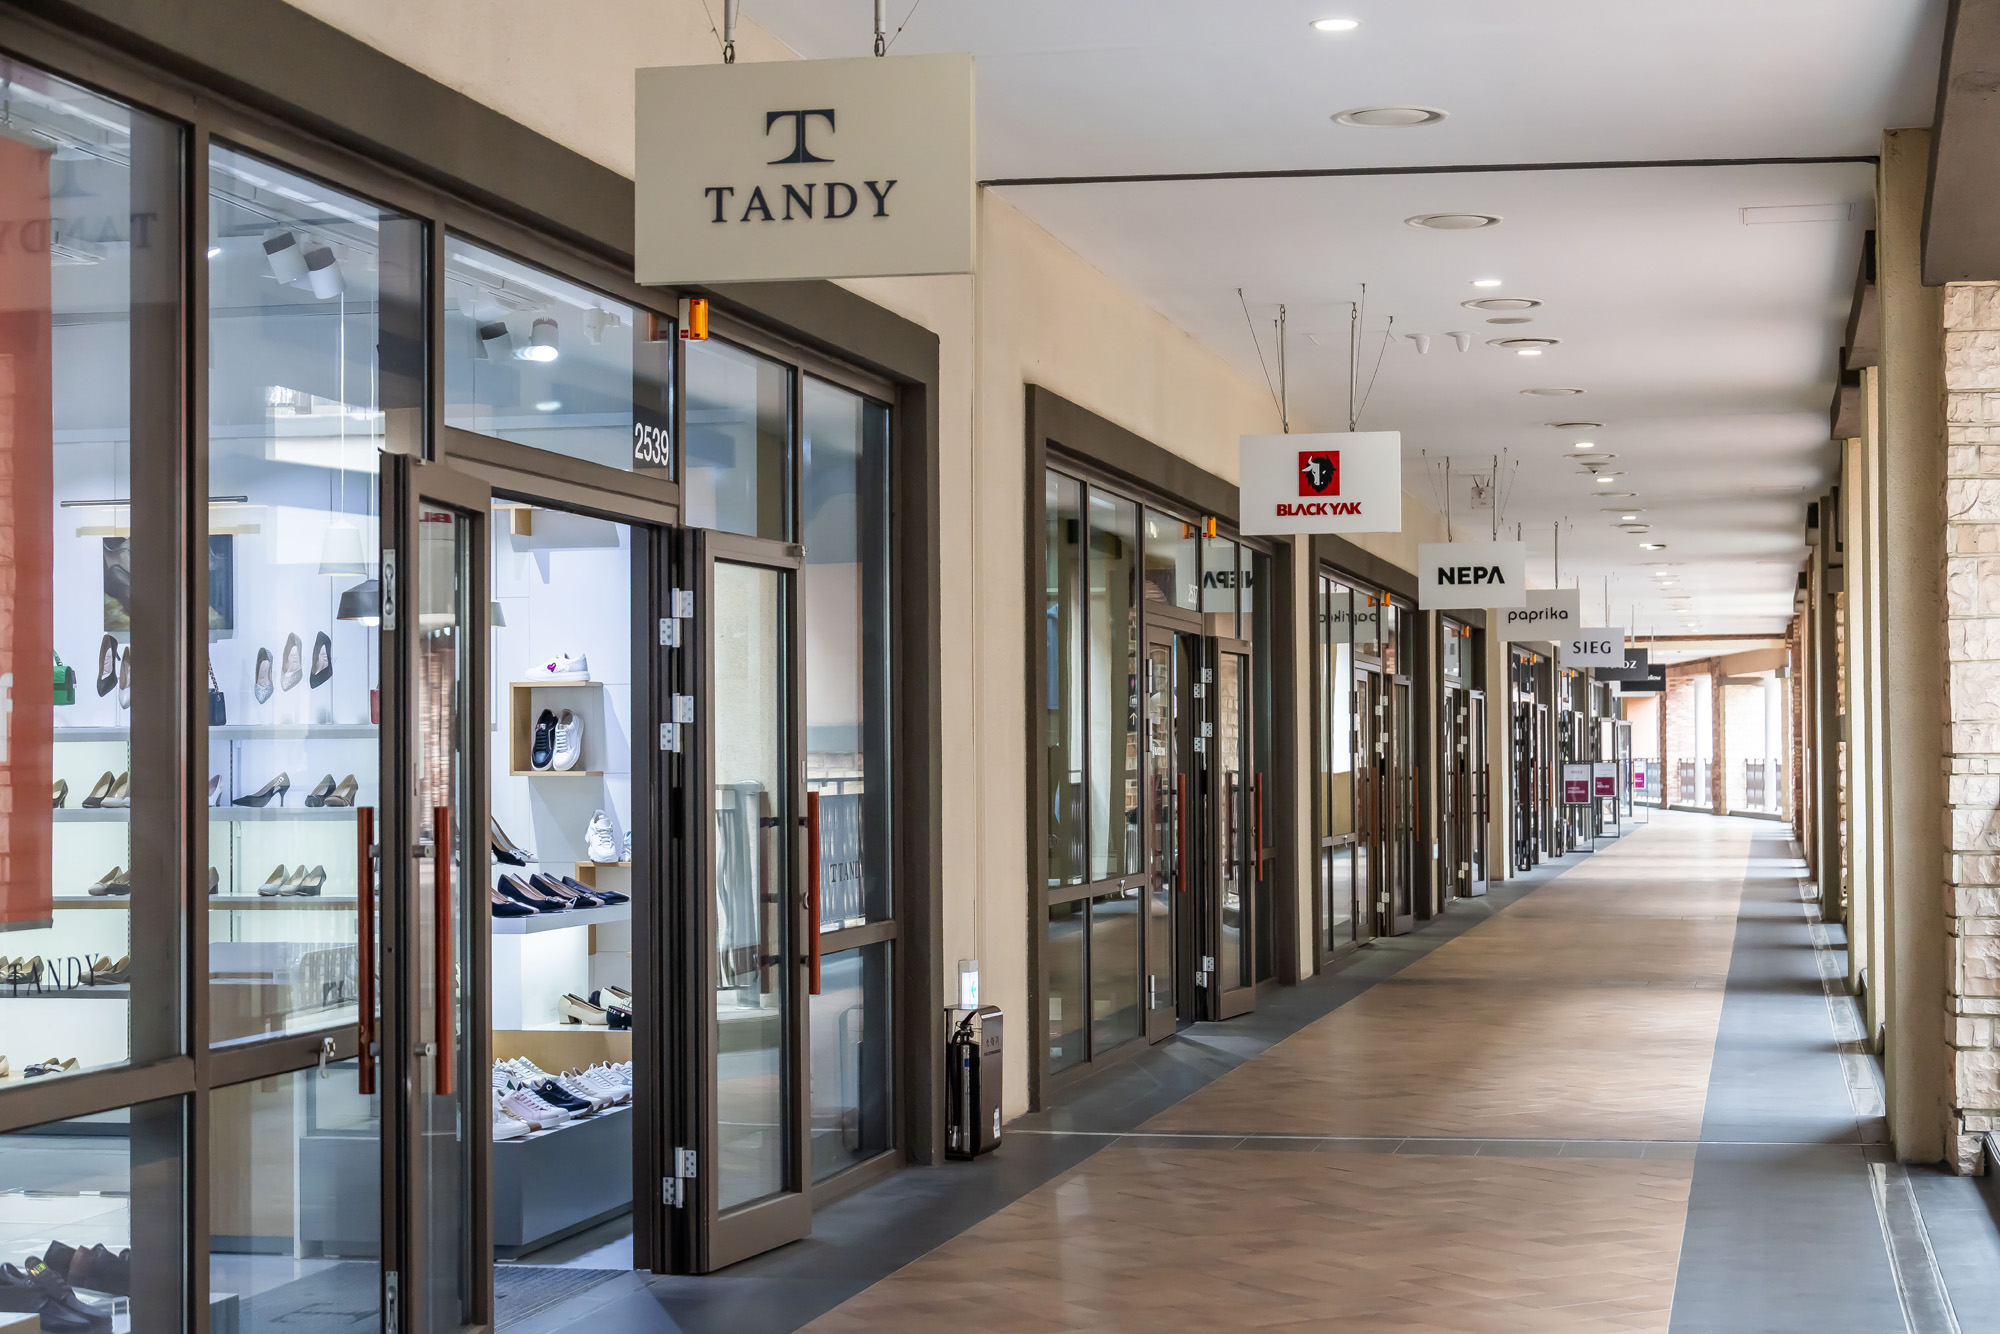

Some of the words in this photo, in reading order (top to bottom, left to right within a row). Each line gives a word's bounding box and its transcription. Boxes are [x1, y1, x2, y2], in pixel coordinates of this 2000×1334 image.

[766, 108, 836, 165] T
[704, 179, 898, 223] TANDY
[634, 422, 670, 467] 2539
[1437, 565, 1506, 585] NEPA
[1507, 606, 1569, 624] paprika
[1572, 640, 1612, 655] SIEG
[7, 953, 99, 998] TANDY
